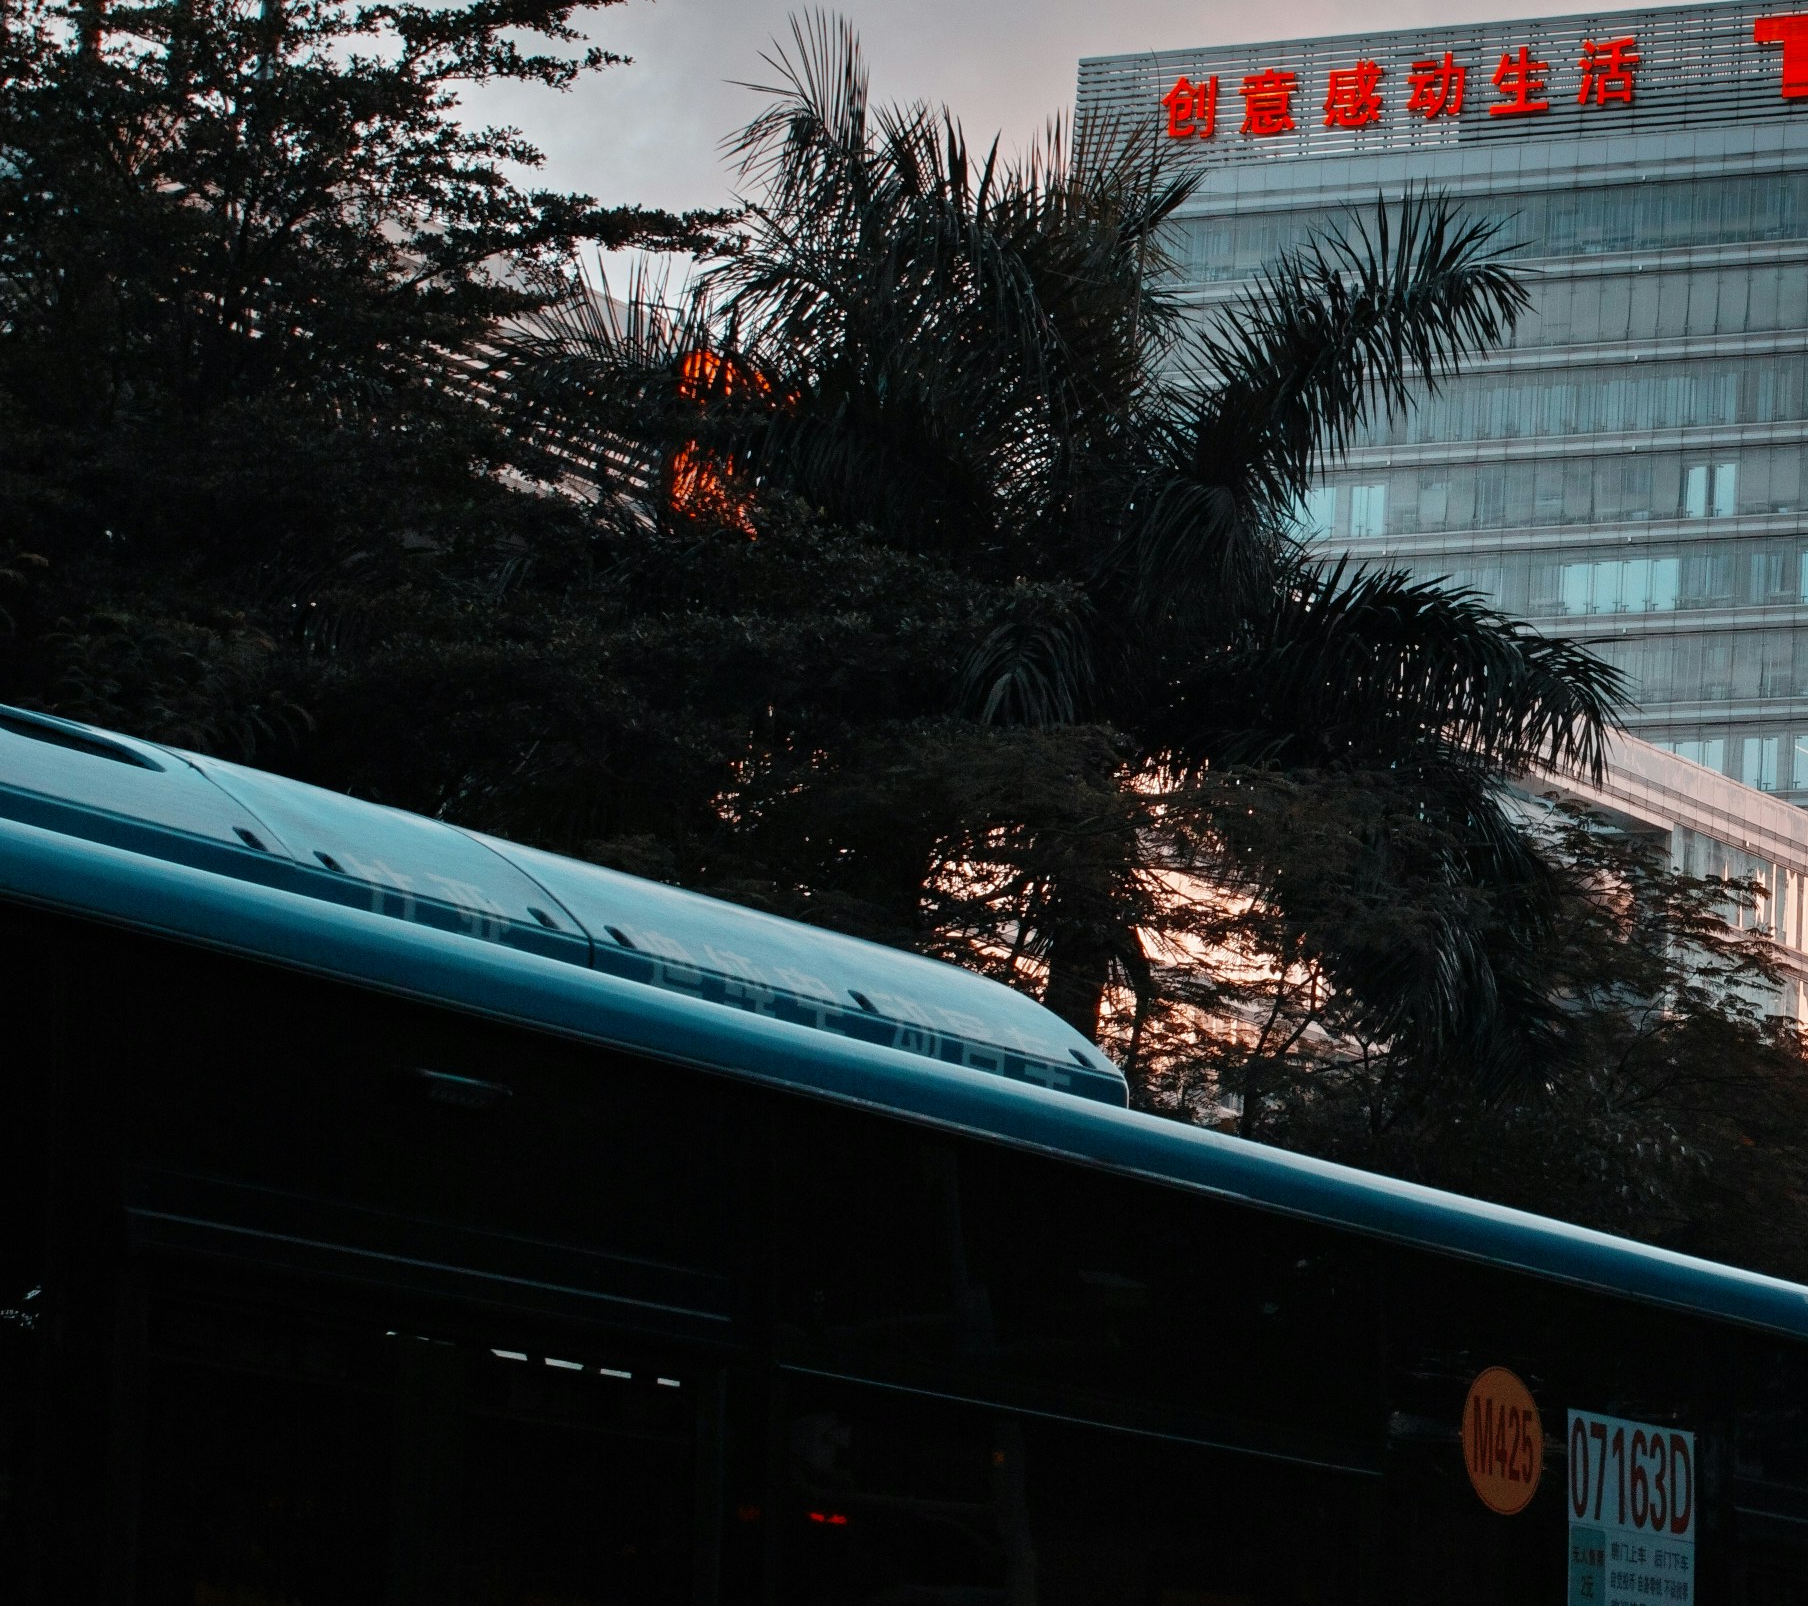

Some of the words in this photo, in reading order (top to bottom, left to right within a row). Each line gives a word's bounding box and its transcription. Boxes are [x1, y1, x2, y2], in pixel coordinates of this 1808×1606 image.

[1161, 35, 1639, 140] 创意感动生活
[1472, 1394, 1535, 1484] M425
[1571, 1417, 1692, 1534] 07163D
